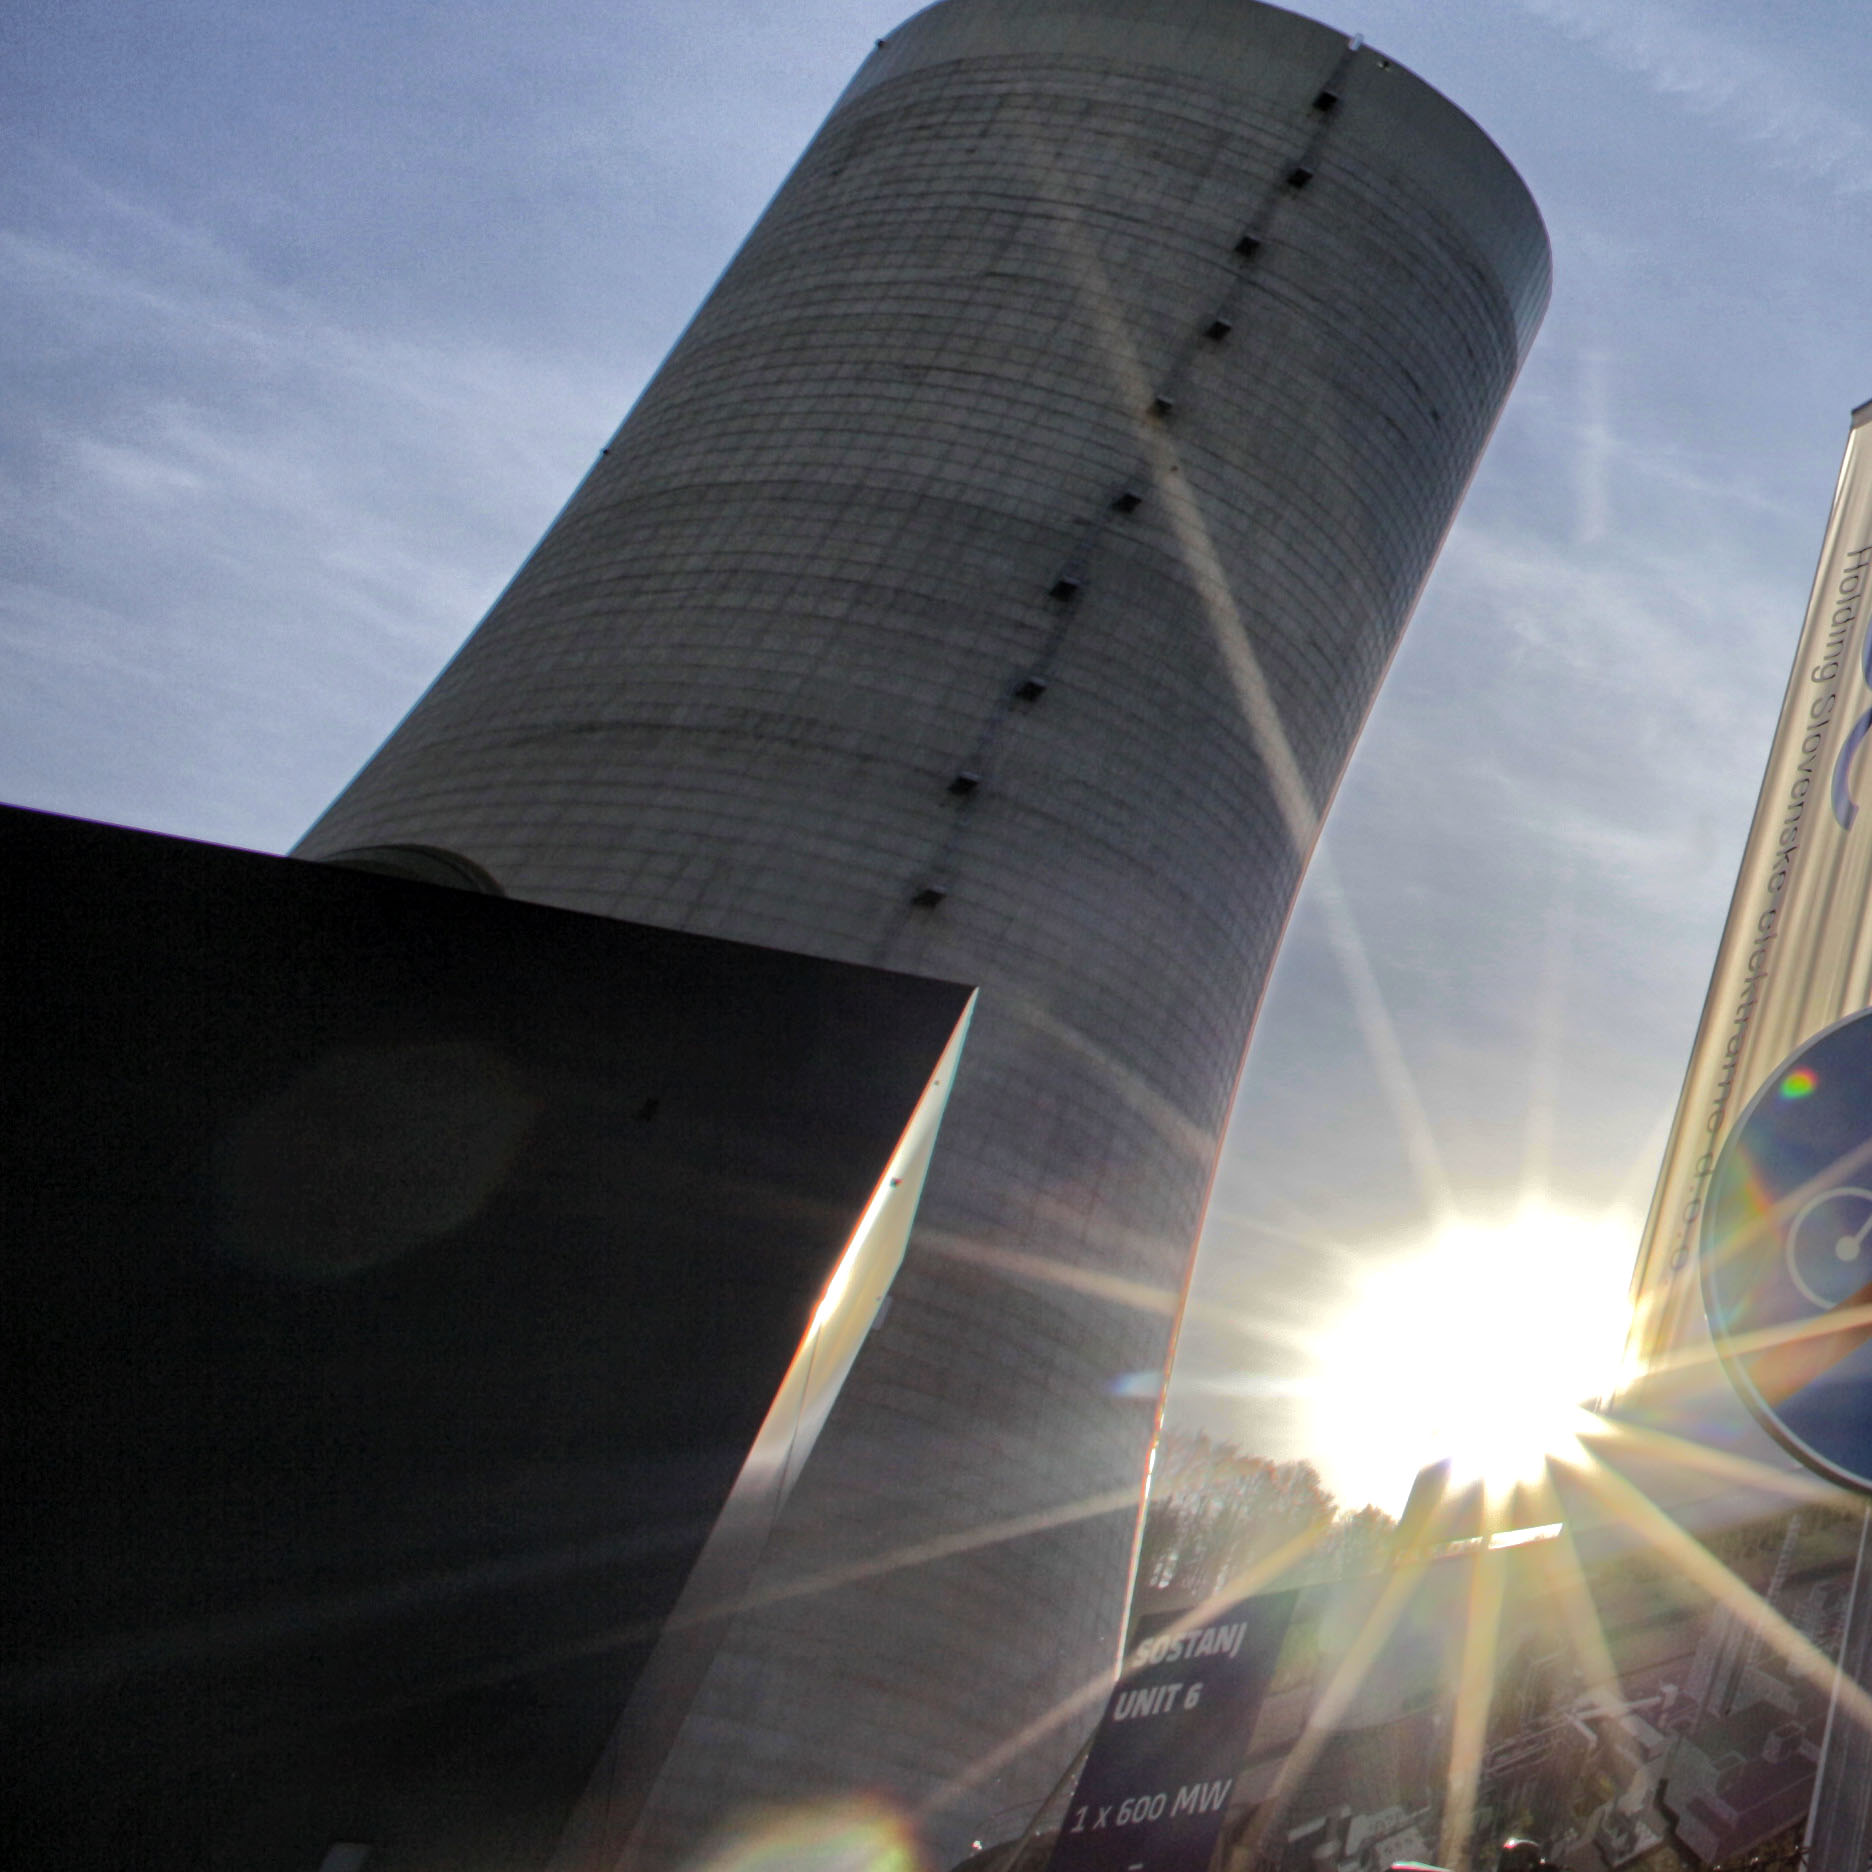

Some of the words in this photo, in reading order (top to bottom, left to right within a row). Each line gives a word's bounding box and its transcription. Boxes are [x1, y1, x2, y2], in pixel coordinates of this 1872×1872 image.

[1811, 544, 1872, 684] Holding
[1767, 693, 1838, 894] Slovenske
[1705, 909, 1779, 1135] elektrarne
[1113, 1683, 1184, 1722] UNIT
[1184, 1683, 1204, 1709] 6
[1070, 1806, 1089, 1833] 1
[1115, 1793, 1168, 1827] 600
[1170, 1779, 1233, 1818] MW
